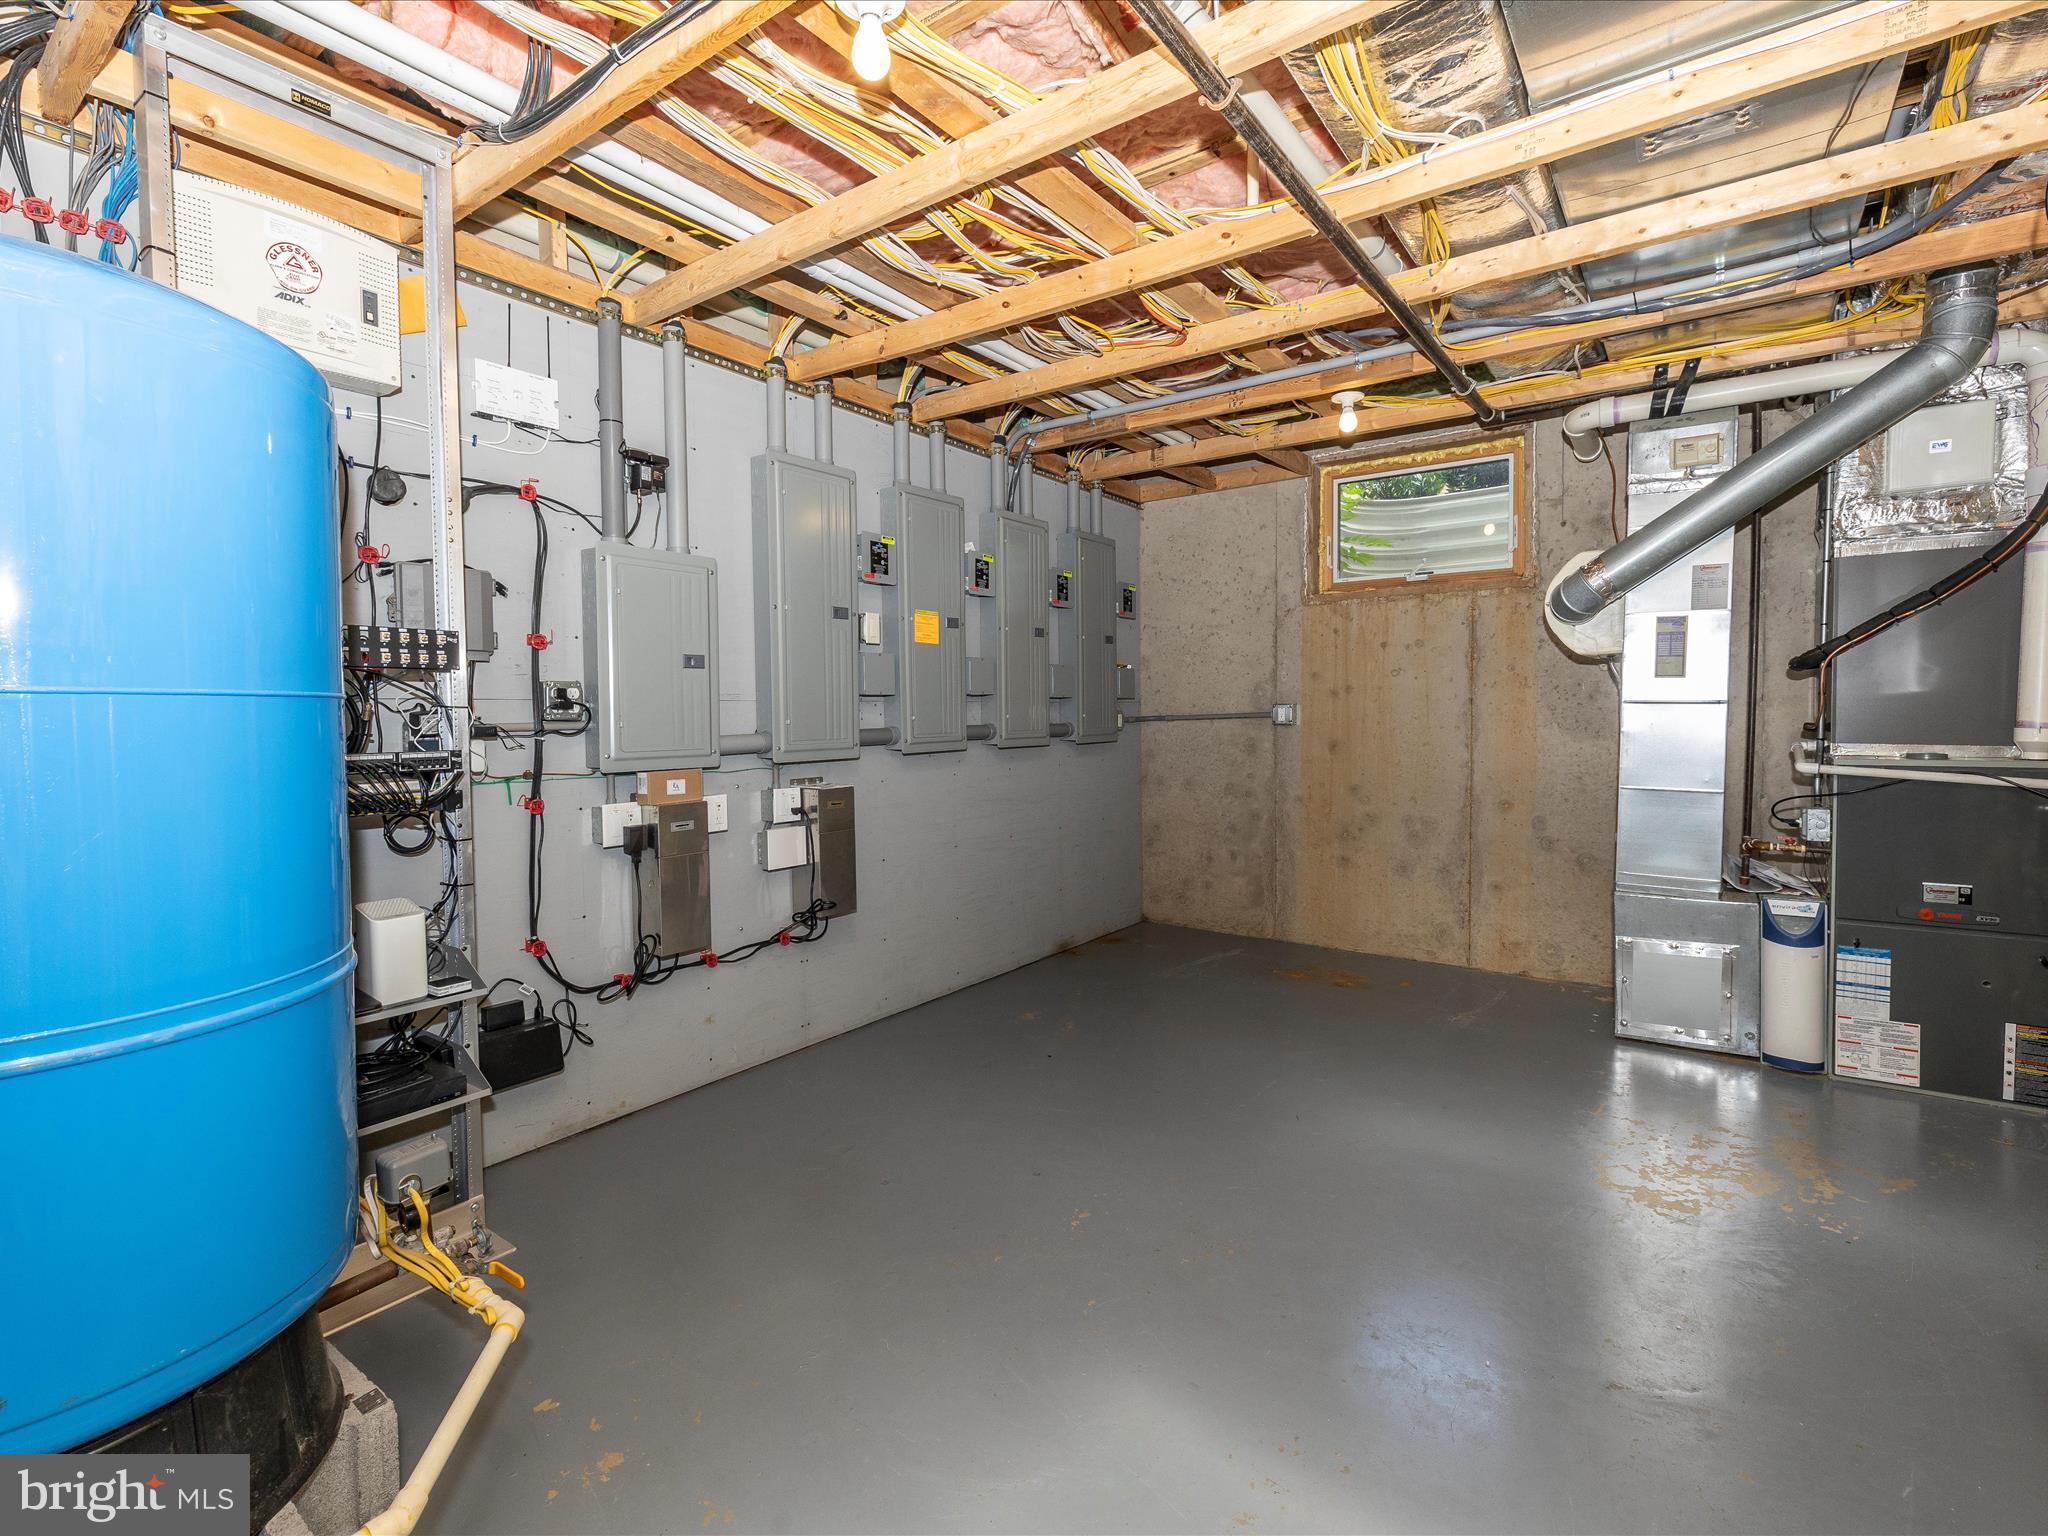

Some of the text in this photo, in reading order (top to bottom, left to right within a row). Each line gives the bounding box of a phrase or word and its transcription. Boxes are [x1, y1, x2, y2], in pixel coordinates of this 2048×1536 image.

[302, 95, 331, 111] HOMACO
[269, 245, 319, 273] GLESSNER
[274, 291, 305, 306] ADIX
